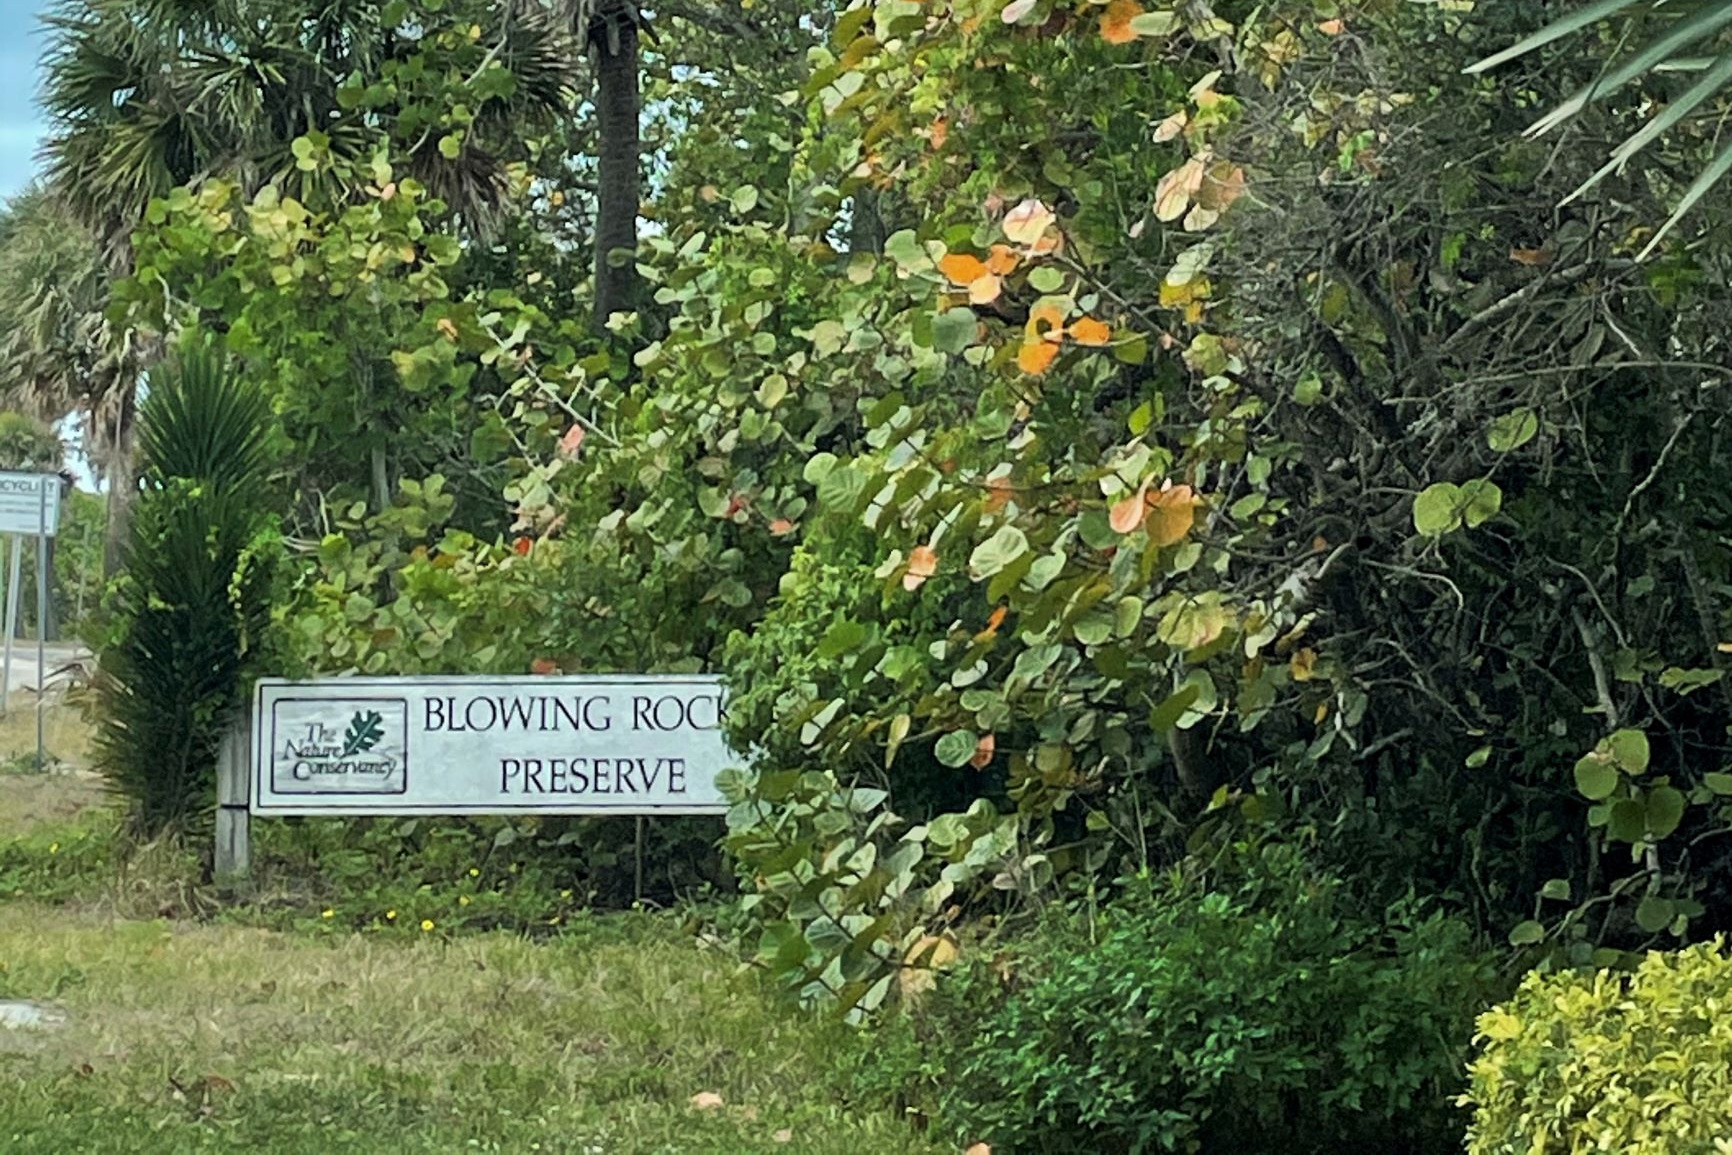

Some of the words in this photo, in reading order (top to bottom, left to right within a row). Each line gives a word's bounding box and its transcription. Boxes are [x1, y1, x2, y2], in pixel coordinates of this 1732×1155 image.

[425, 696, 611, 732] BLOWING
[305, 722, 336, 743] The
[282, 738, 342, 760] Nature
[293, 759, 397, 781] Conservancy
[501, 758, 687, 794] PRESERVE
